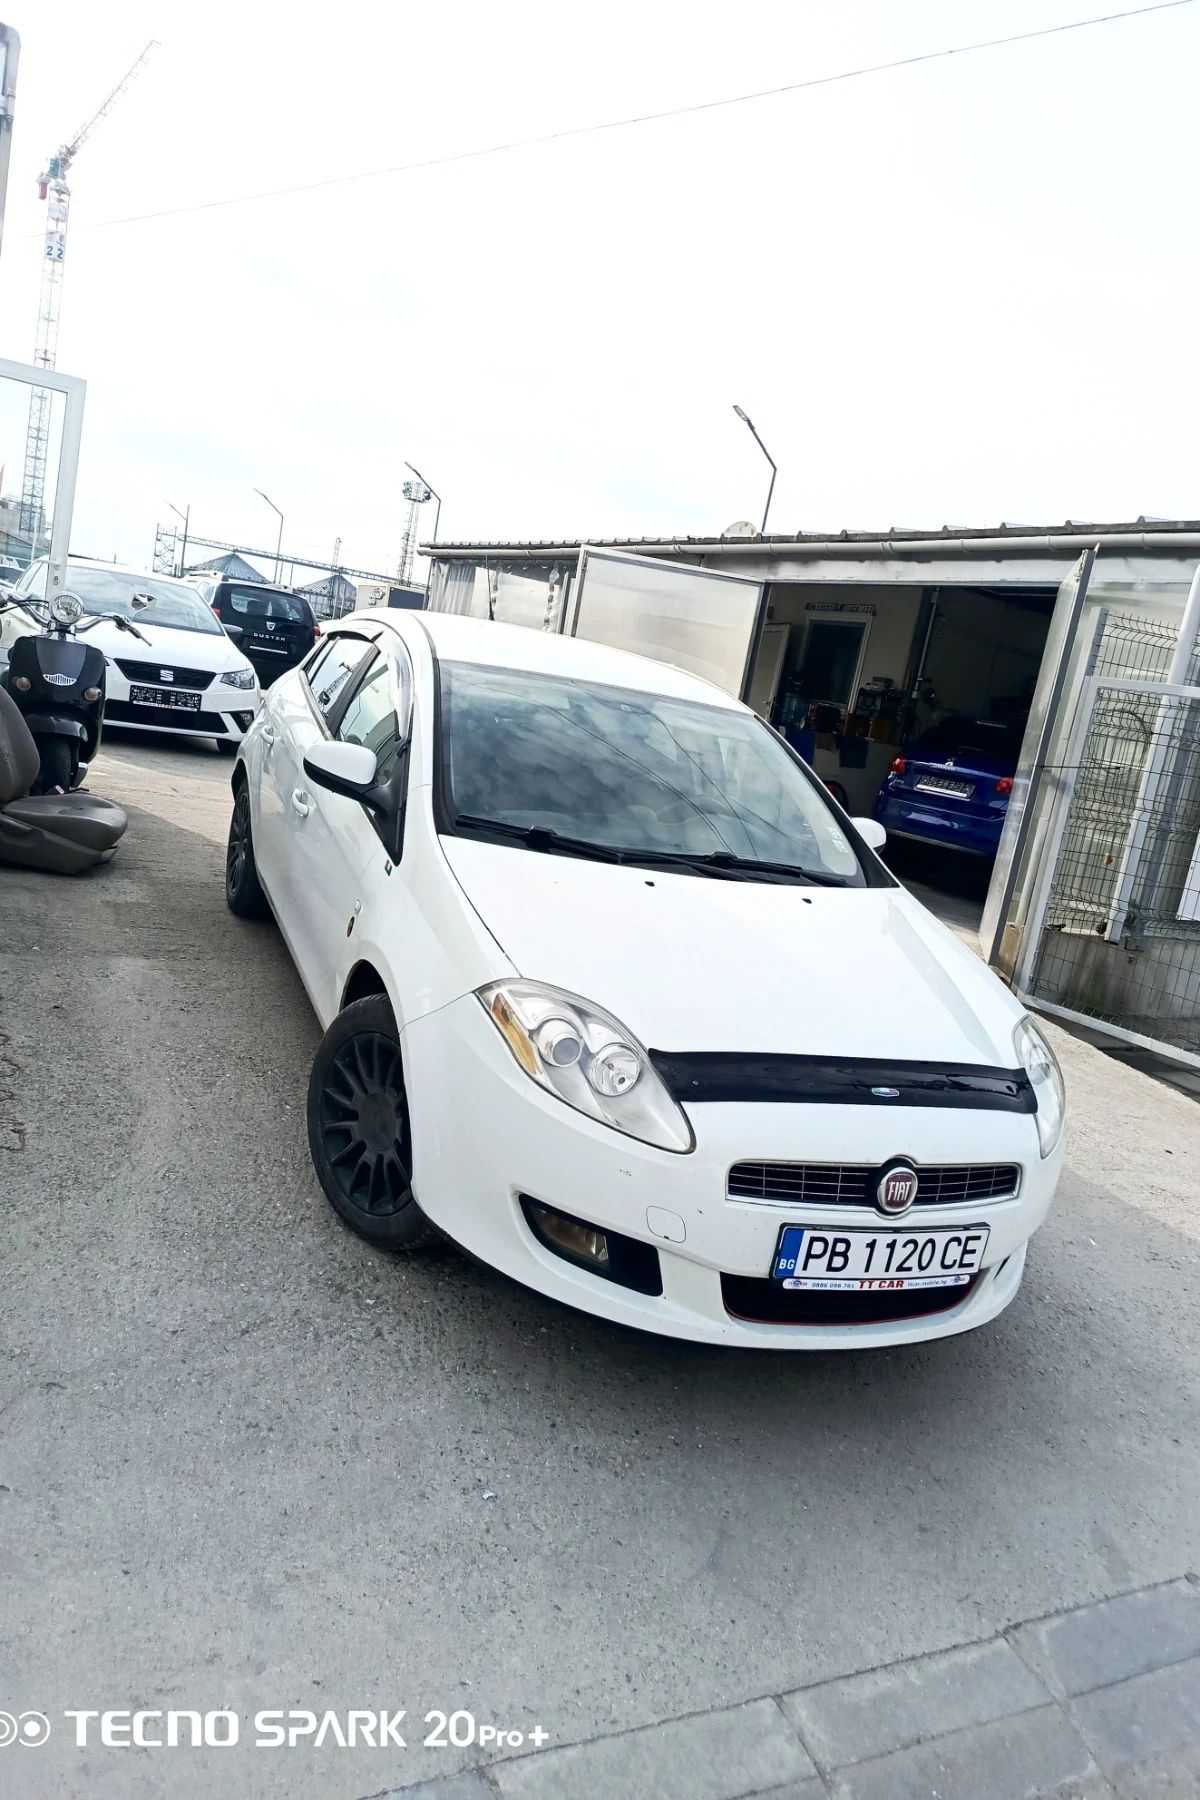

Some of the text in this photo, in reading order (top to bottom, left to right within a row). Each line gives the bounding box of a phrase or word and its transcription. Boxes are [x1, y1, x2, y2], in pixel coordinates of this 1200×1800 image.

[46, 245, 54, 256] 2
[253, 632, 286, 641] DUSTER
[887, 1181, 912, 1201] FIAT
[802, 1235, 982, 1273] PB 1120 CE
[778, 1258, 796, 1270] BG
[858, 1280, 875, 1290] TT
[878, 1280, 905, 1290] CAR
